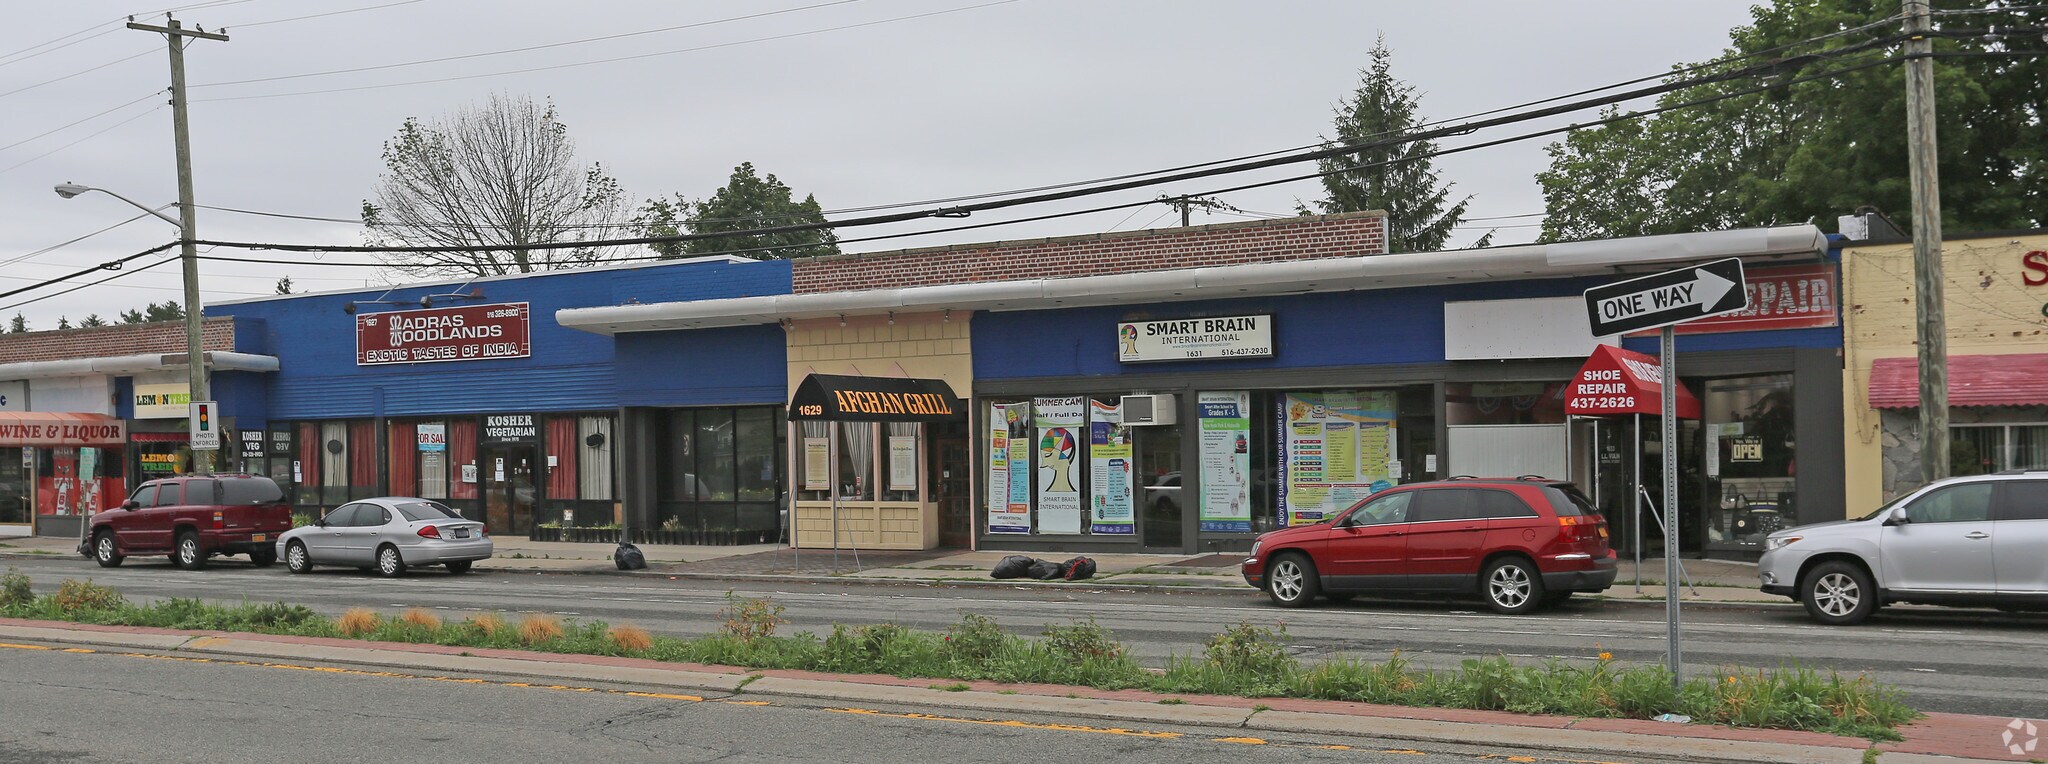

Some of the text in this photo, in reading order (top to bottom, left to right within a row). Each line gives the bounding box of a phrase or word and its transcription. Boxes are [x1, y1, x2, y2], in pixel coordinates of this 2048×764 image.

[1603, 283, 1695, 319] ONE WAY
[1720, 279, 1832, 317] EPAIR
[366, 319, 378, 327] 1627
[1146, 317, 1256, 336] SMART BRAIN
[1162, 334, 1240, 345] INTERNATIONAL
[366, 342, 519, 362] EXOTIC TASTES OF INDIA
[1221, 347, 1269, 356] 516-437-2930
[1583, 369, 1621, 381] SHOE
[1577, 383, 1627, 395] REPAIR
[834, 390, 953, 415] AFGHAN GRILL
[1570, 397, 1635, 409] 437-2626
[799, 405, 822, 416] 1629
[487, 415, 533, 427] KOSHER
[0, 425, 120, 442] WINE & LIQUOR
[242, 431, 263, 441] KOSHER
[485, 427, 536, 437] VEGETARIAN
[245, 442, 260, 450] VEG
[1733, 444, 1761, 459] OPEN
